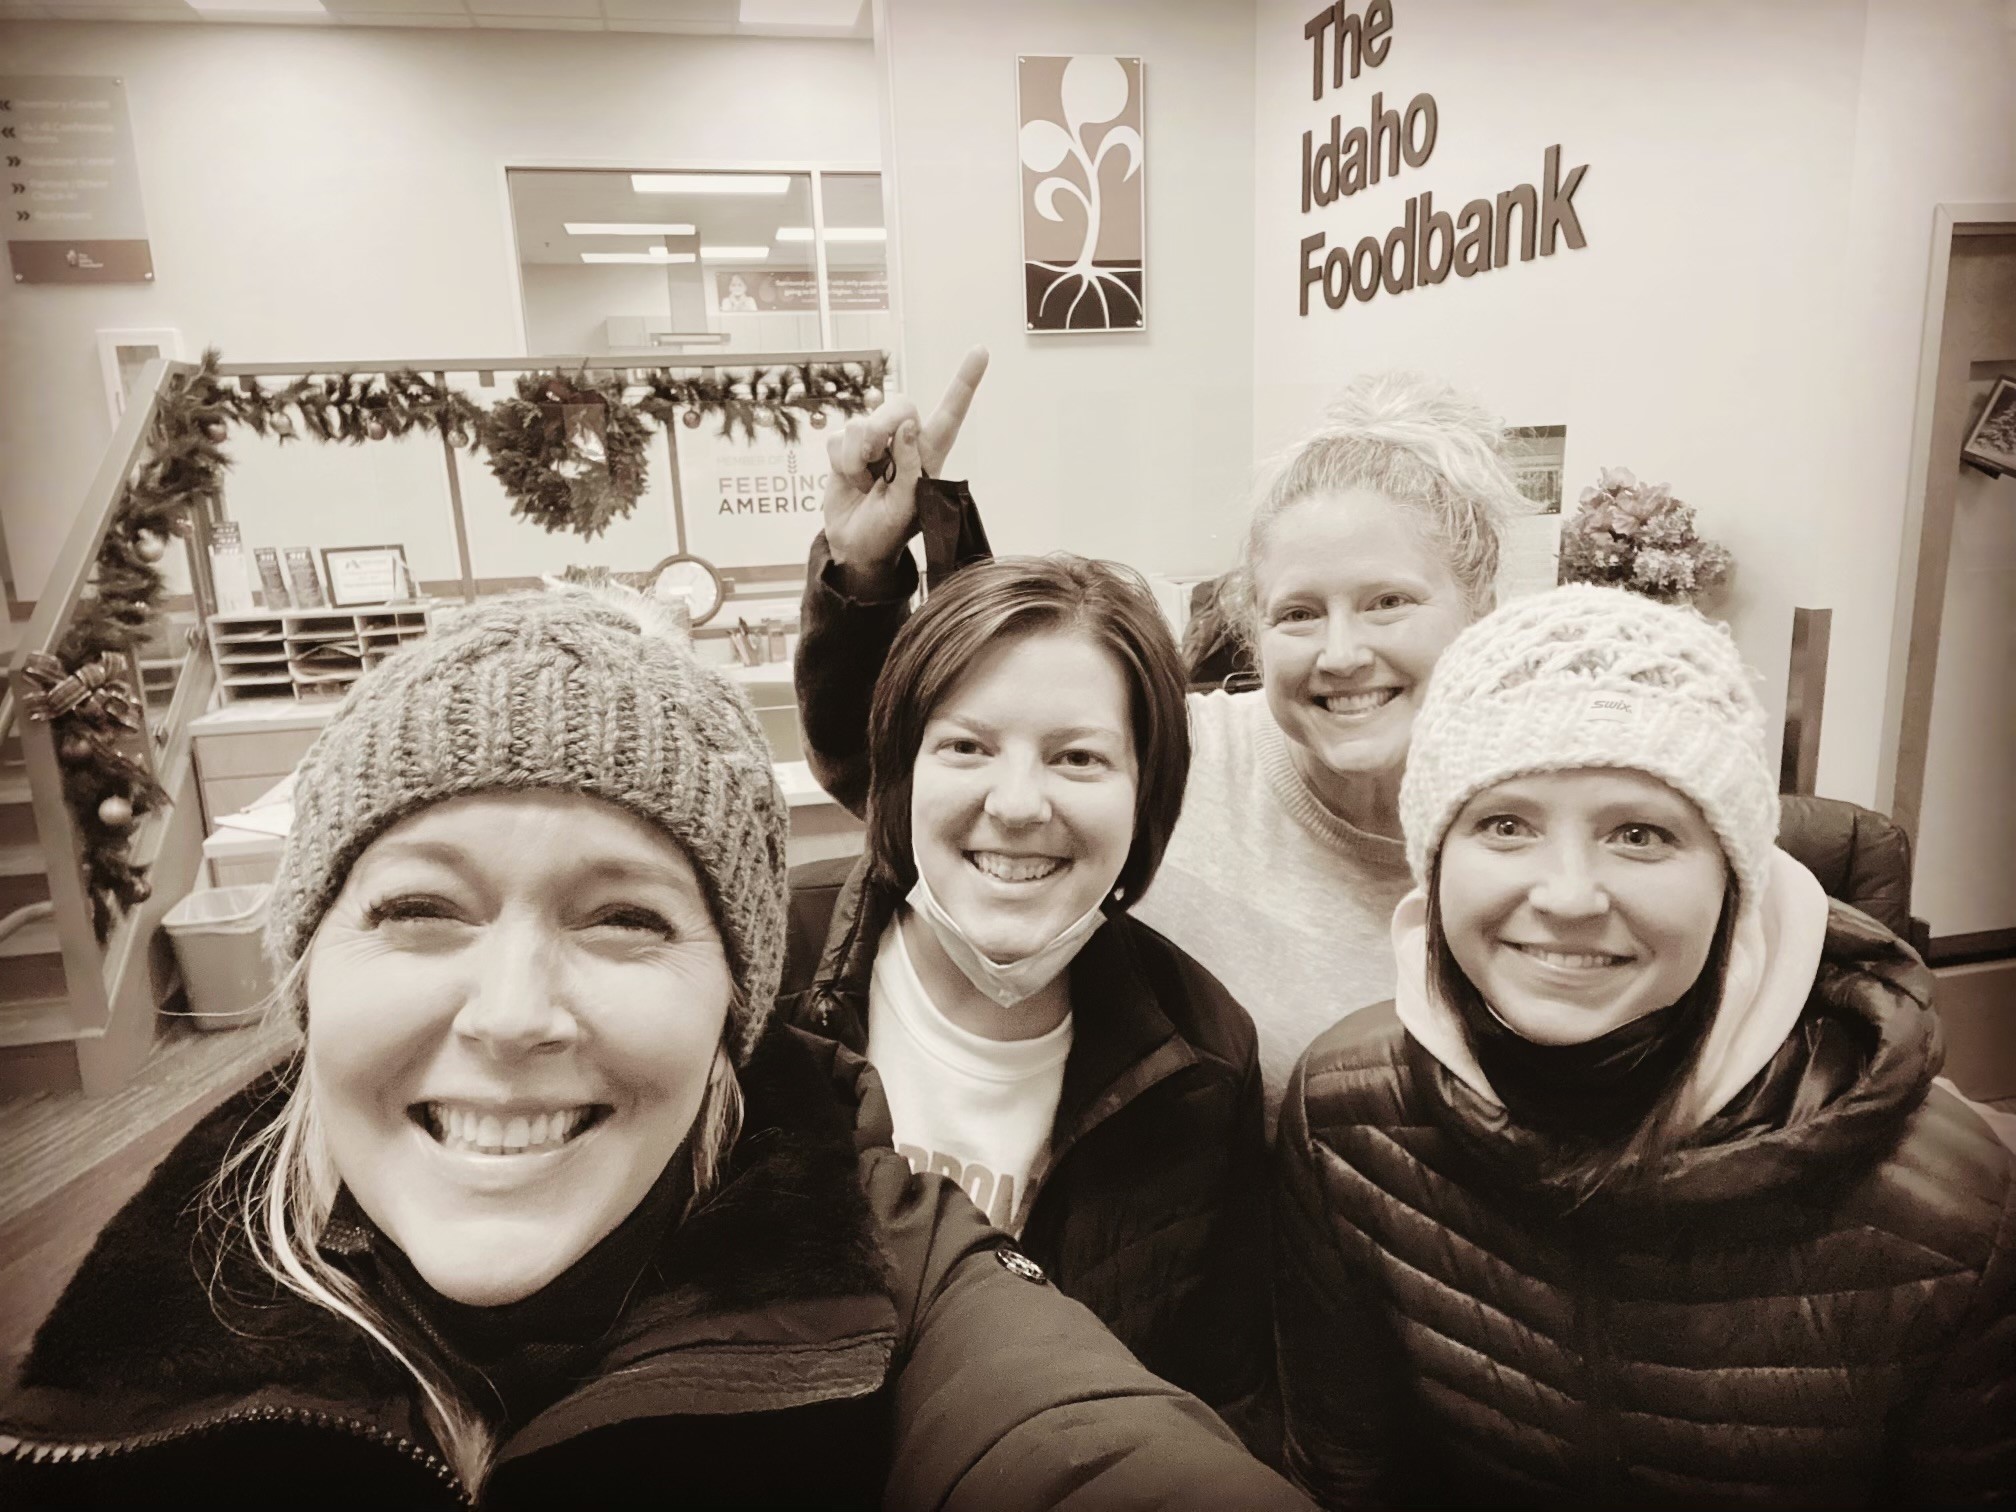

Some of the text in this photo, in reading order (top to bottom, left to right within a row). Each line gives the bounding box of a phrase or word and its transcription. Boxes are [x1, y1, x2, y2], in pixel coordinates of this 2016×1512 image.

[1304, 0, 1394, 101] The
[1301, 91, 1439, 214] Idaho
[1299, 143, 1591, 317] Foodbank
[718, 495, 825, 516] AMERIC
